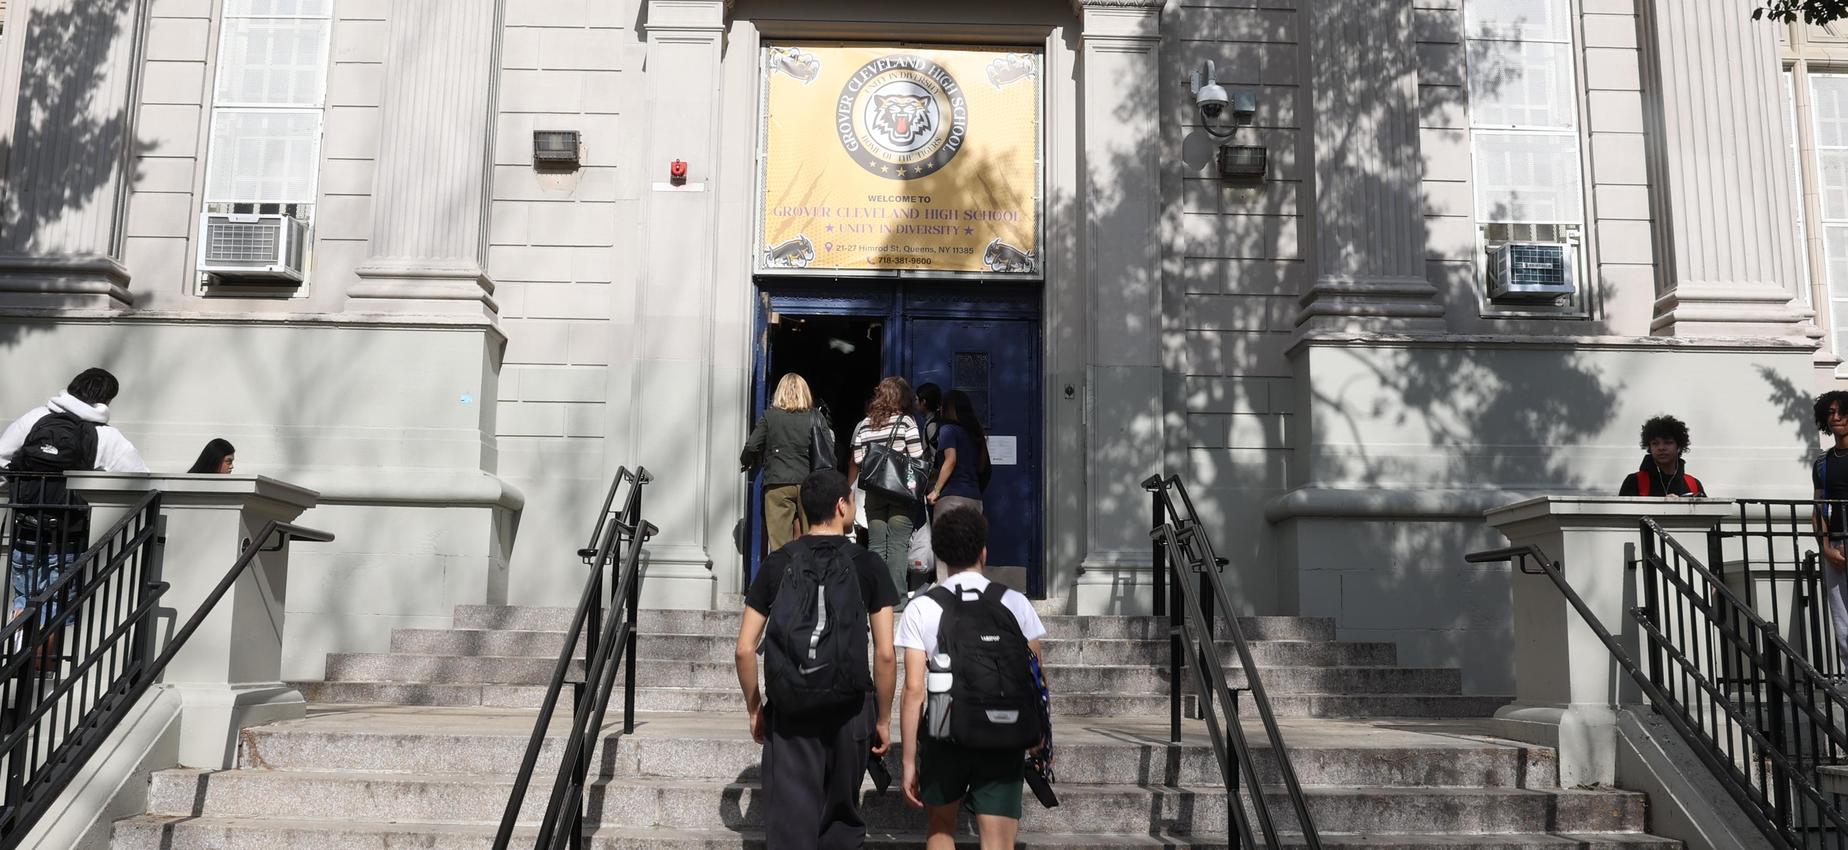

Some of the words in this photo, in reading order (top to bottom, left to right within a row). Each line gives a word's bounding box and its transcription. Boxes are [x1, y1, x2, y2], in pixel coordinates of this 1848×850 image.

[848, 56, 926, 92] CLEVELAND
[900, 71, 940, 95] DIVERSITY
[928, 65, 958, 95] HIGH
[838, 96, 859, 152] GROVER
[943, 97, 966, 152] SCHOOL
[868, 195, 916, 203] WELCOME
[919, 195, 931, 203] TO
[773, 206, 831, 218] GROVER
[836, 207, 920, 219] CLEVELAND
[925, 208, 958, 220] HIGH
[963, 209, 1018, 221] SCHOOL
[840, 223, 874, 233] UNITY
[880, 224, 892, 234] IN
[896, 225, 960, 235] DIVERSITY
[836, 244, 857, 252] 21-27
[859, 244, 888, 252] Himrod
[903, 246, 936, 254] Queens,
[952, 247, 974, 255] 11385
[878, 256, 932, 265] 718-381-9600
